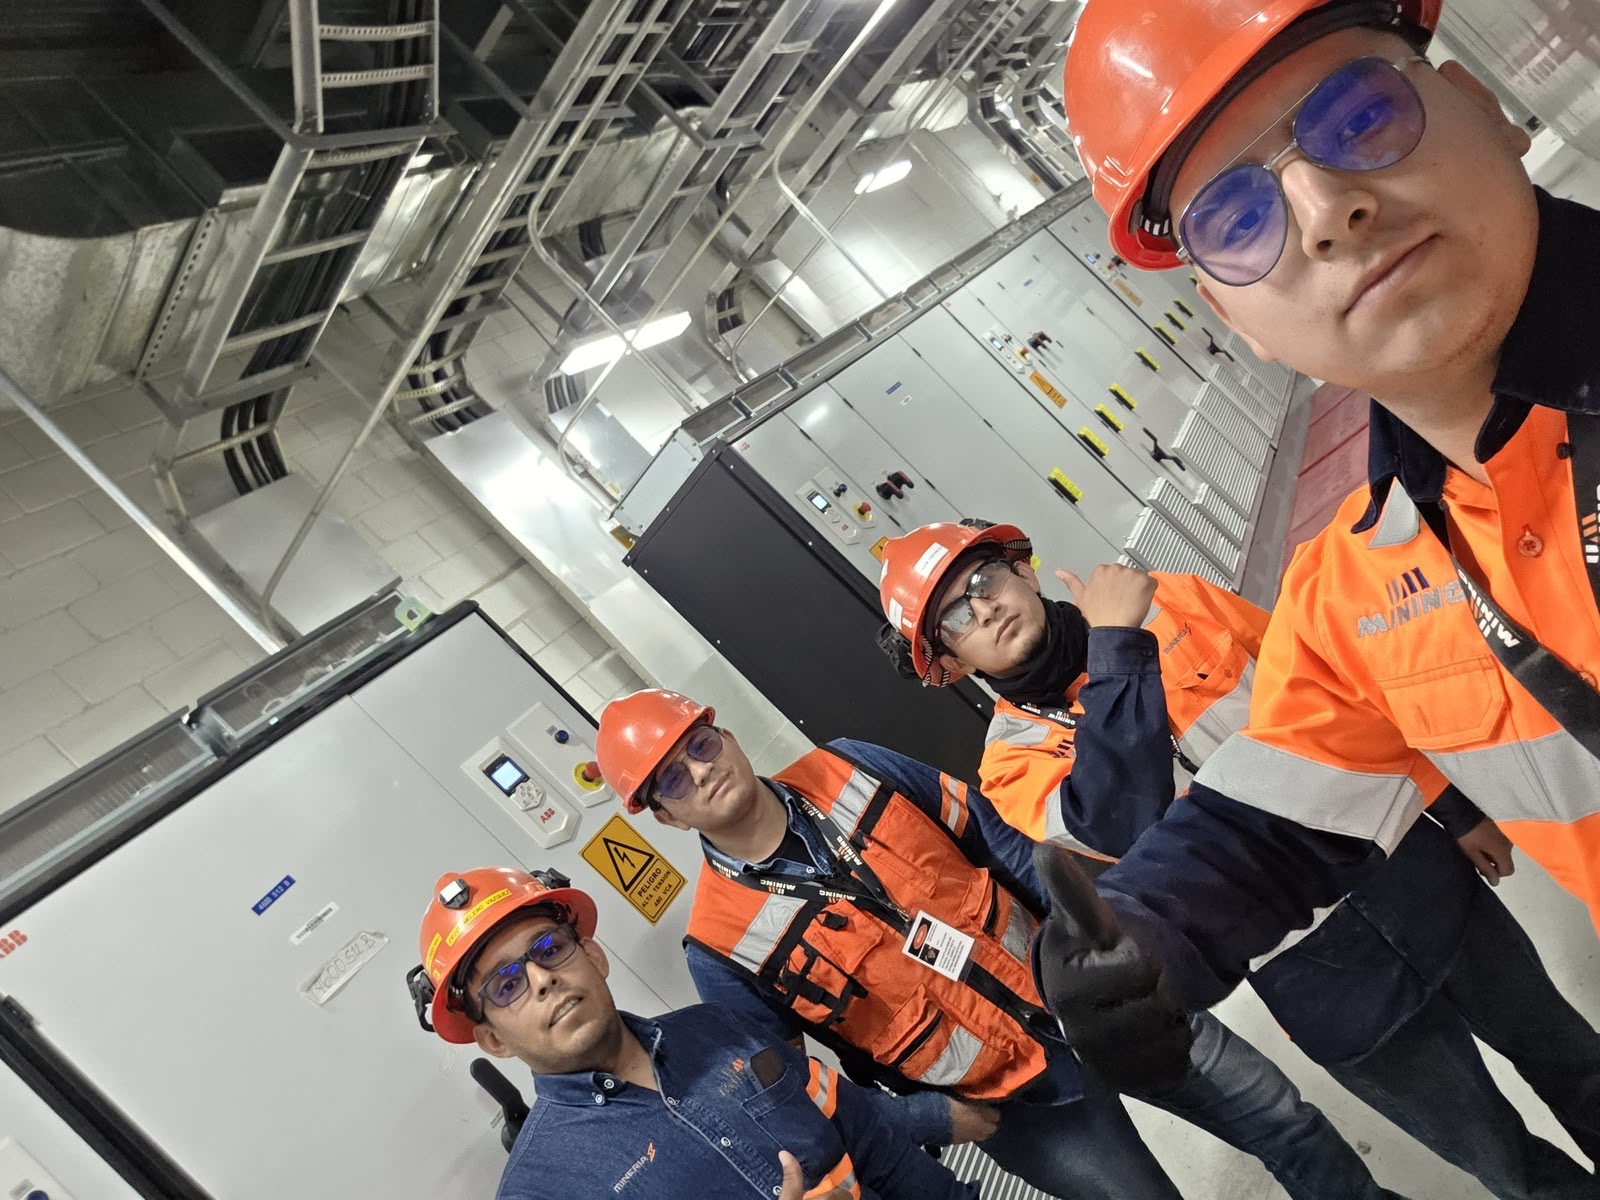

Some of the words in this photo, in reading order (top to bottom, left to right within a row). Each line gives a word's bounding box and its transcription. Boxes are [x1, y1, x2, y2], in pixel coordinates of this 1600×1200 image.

[1357, 579, 1466, 638] MINING
[1457, 568, 1521, 648] MINING
[1047, 713, 1076, 726] MINING
[540, 807, 556, 824] ABB
[836, 835, 863, 866] MINING
[637, 867, 662, 898] PELIGRO
[641, 894, 654, 908] ALTA
[653, 870, 671, 893] TENSION
[662, 884, 673, 895] VCA
[760, 879, 796, 891] MINING
[818, 889, 857, 901] MINING
[0, 929, 28, 959] BB
[613, 1155, 649, 1194] MINERIA
